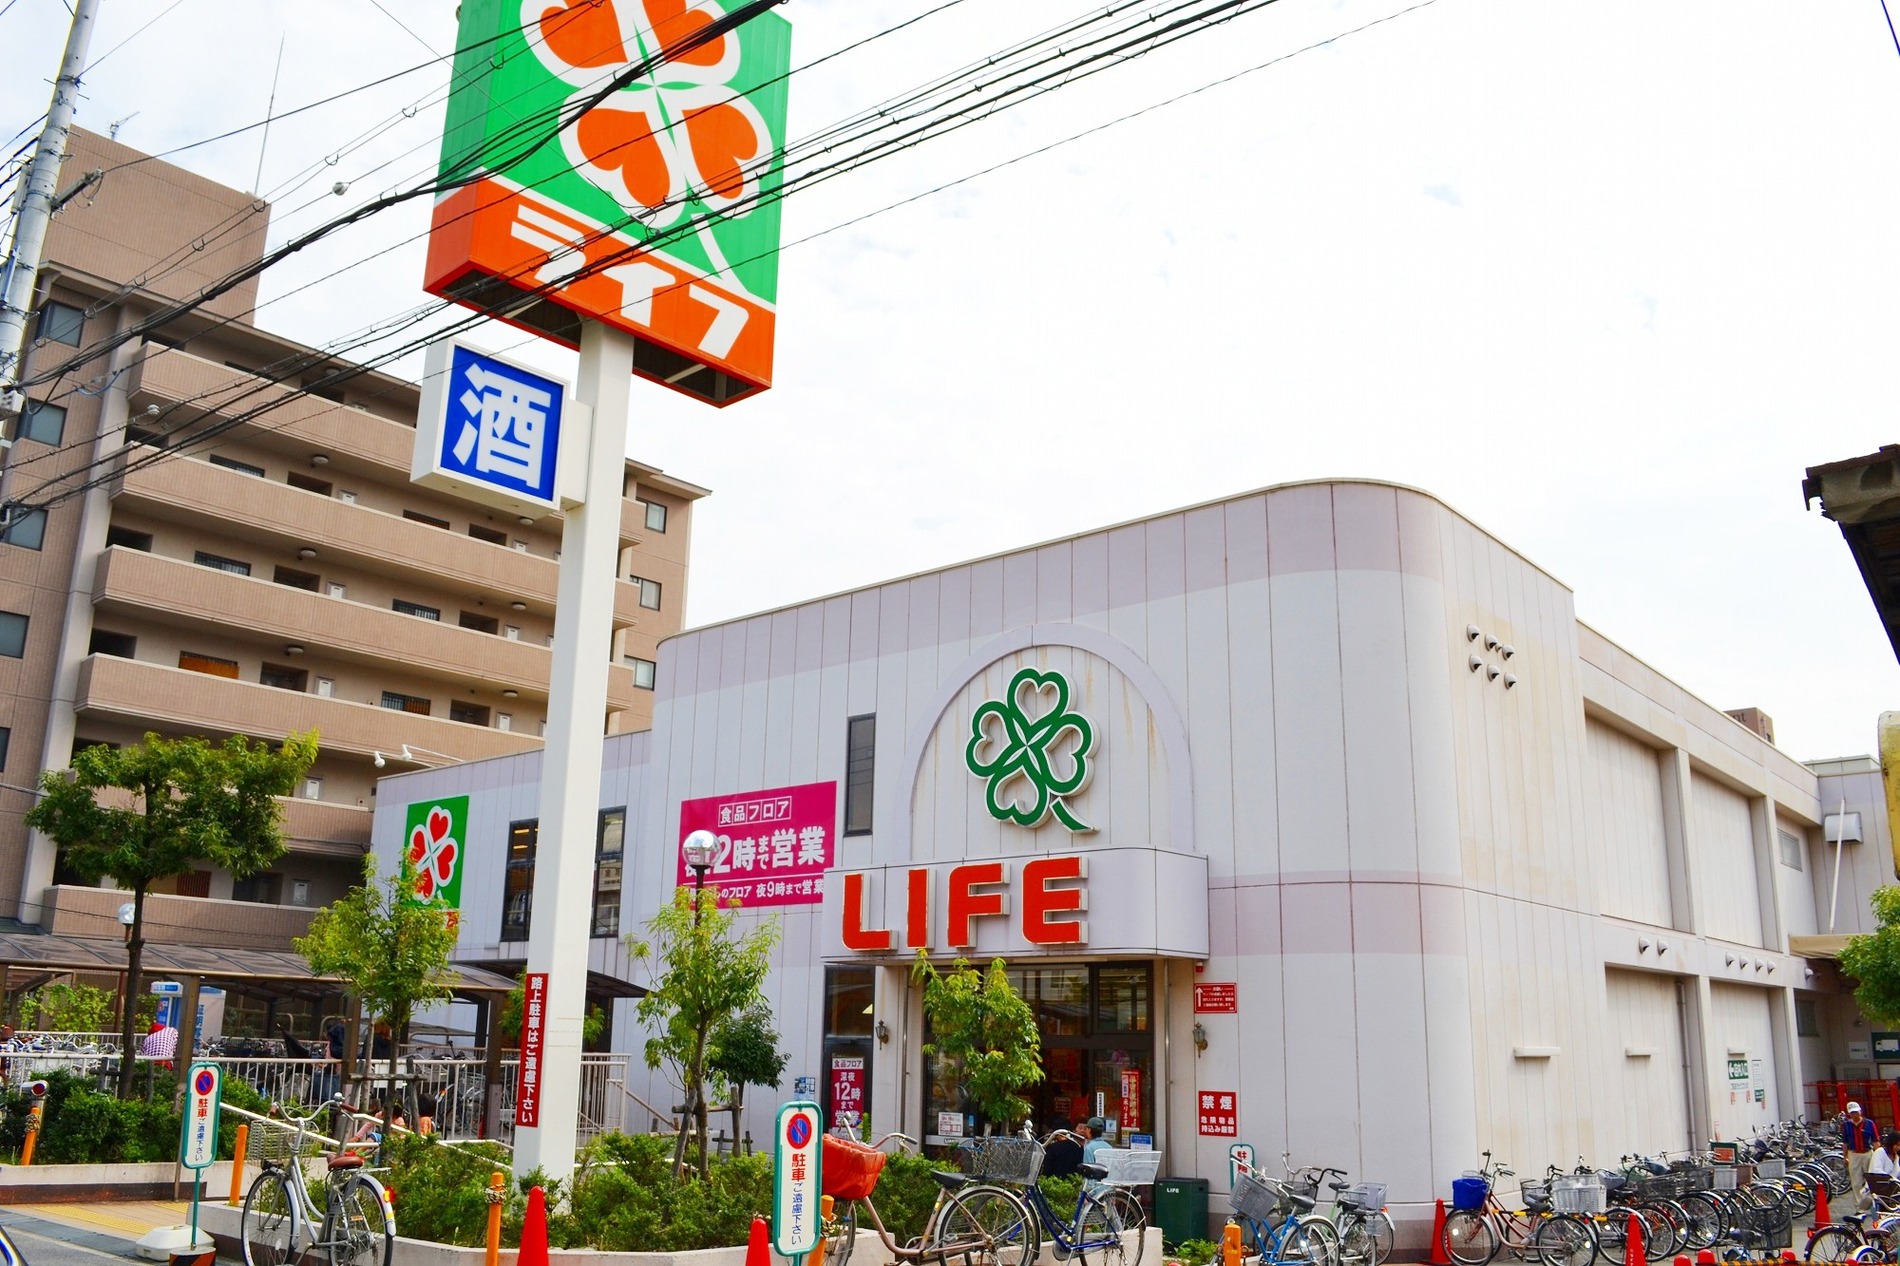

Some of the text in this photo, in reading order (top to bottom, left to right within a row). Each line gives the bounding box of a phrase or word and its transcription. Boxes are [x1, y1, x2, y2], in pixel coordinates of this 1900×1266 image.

[510, 203, 750, 360] ライフ
[452, 363, 552, 490] 酒
[720, 800, 790, 824] 食品フロア
[842, 856, 1086, 950] LIFE
[521, 976, 543, 1123] 路上駐車はご遠慮下さい
[834, 1060, 862, 1068] 食品フロア
[834, 1082, 861, 1101] 12時
[840, 1072, 855, 1081] 深夜
[840, 1101, 854, 1109] まで
[1202, 1095, 1233, 1110] 禁煙
[195, 1098, 208, 1161] 駐車ご遠慮下さい
[791, 1153, 807, 1245] 駐車ご遠慮下さい
